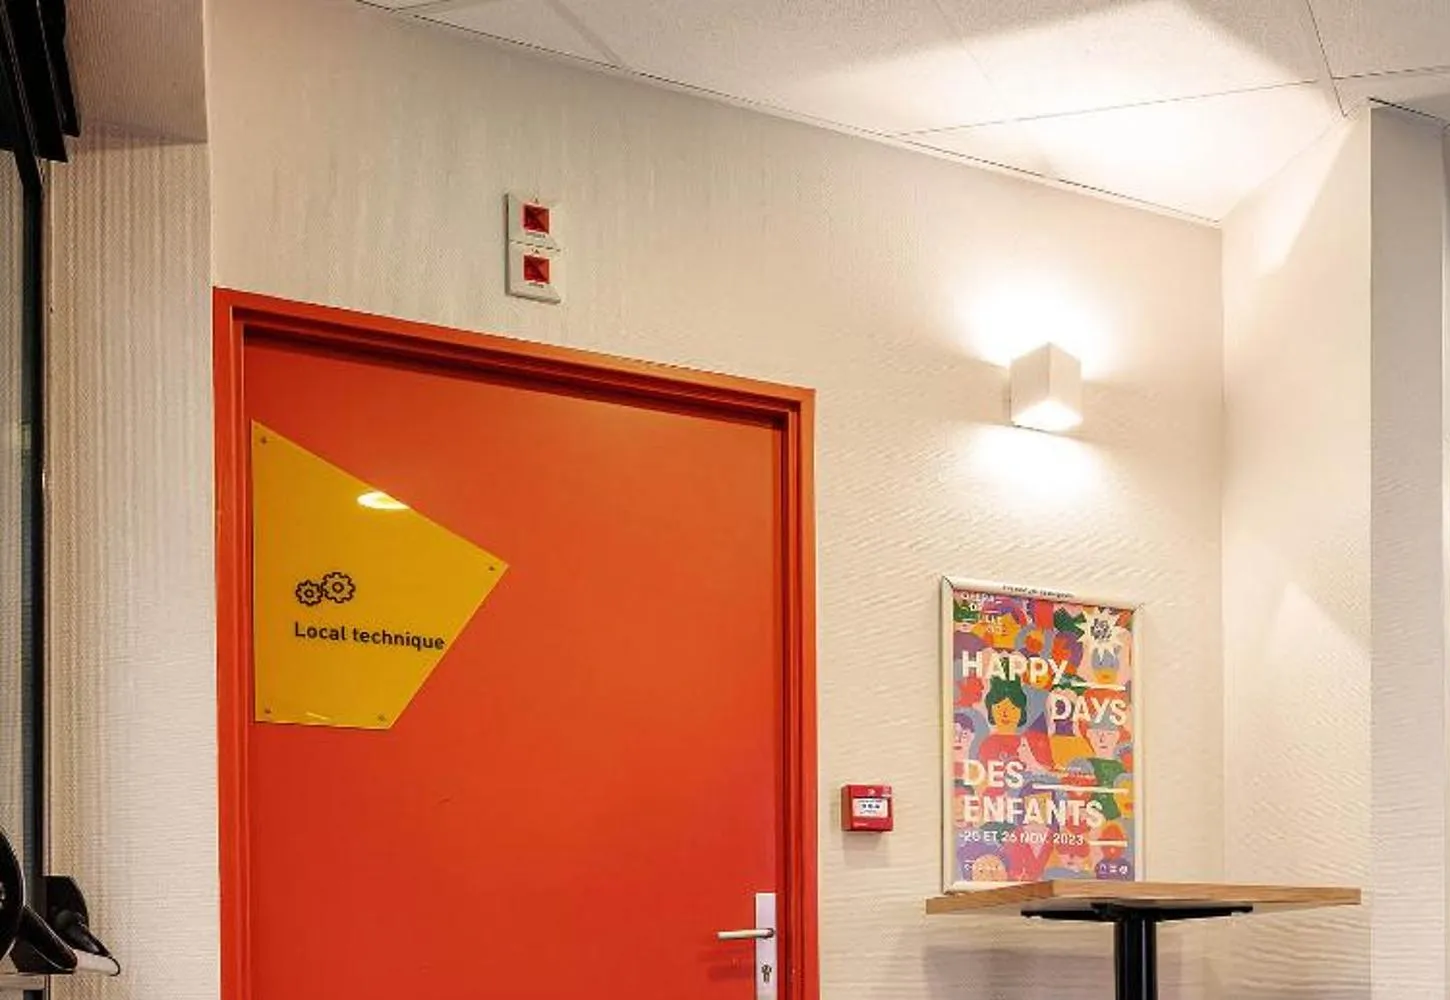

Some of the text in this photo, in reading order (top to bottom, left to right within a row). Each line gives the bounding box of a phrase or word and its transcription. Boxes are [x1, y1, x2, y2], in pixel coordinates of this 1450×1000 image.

[294, 621, 446, 651] Local technique
[961, 650, 1069, 686] HAPPY
[1050, 693, 1128, 725] DAYS
[962, 759, 1025, 788] DES
[962, 795, 1105, 829] ENFANTS
[984, 831, 998, 843] ET
[1001, 831, 1018, 843] 26
[1053, 832, 1084, 846] 2023
